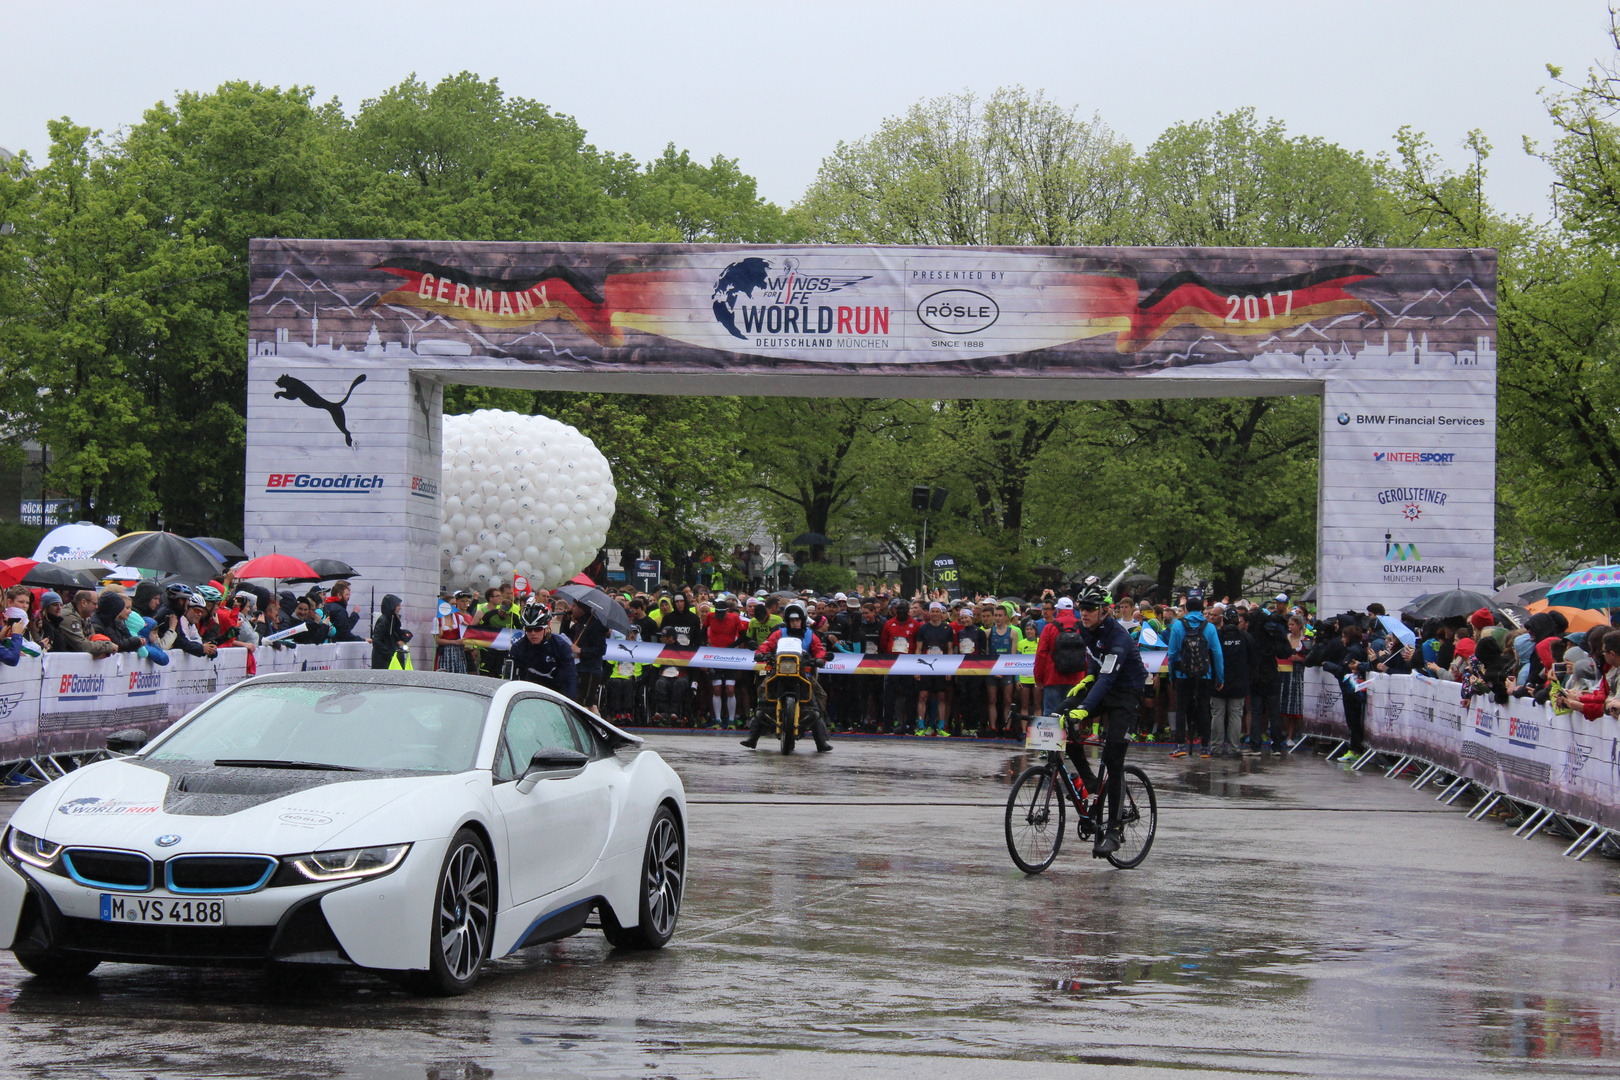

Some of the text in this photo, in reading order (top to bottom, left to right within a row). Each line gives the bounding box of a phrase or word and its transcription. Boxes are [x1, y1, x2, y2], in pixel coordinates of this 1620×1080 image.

[913, 271, 1005, 280] PRESENTED BY
[418, 272, 550, 318] GERMANY
[925, 302, 991, 318] RÖSLE
[1225, 290, 1293, 323] 2017
[756, 337, 889, 348] DEUTSCHLAND MÜNCHEN
[931, 340, 960, 348] SINCE
[1356, 415, 1485, 426] BMW Financial Services
[1386, 452, 1455, 463] INTERSPORT
[266, 474, 384, 488] BFGoodrich
[411, 476, 438, 494] BFGoodrich
[1378, 487, 1447, 506] GEROLSTEINER
[1383, 564, 1445, 573] OLYMPIAPARK
[703, 654, 747, 662] BFGoodrich
[59, 674, 104, 694] BFGoodrich
[129, 670, 161, 690] BFGoodrich
[112, 898, 125, 919] M
[169, 901, 221, 922] 4188
